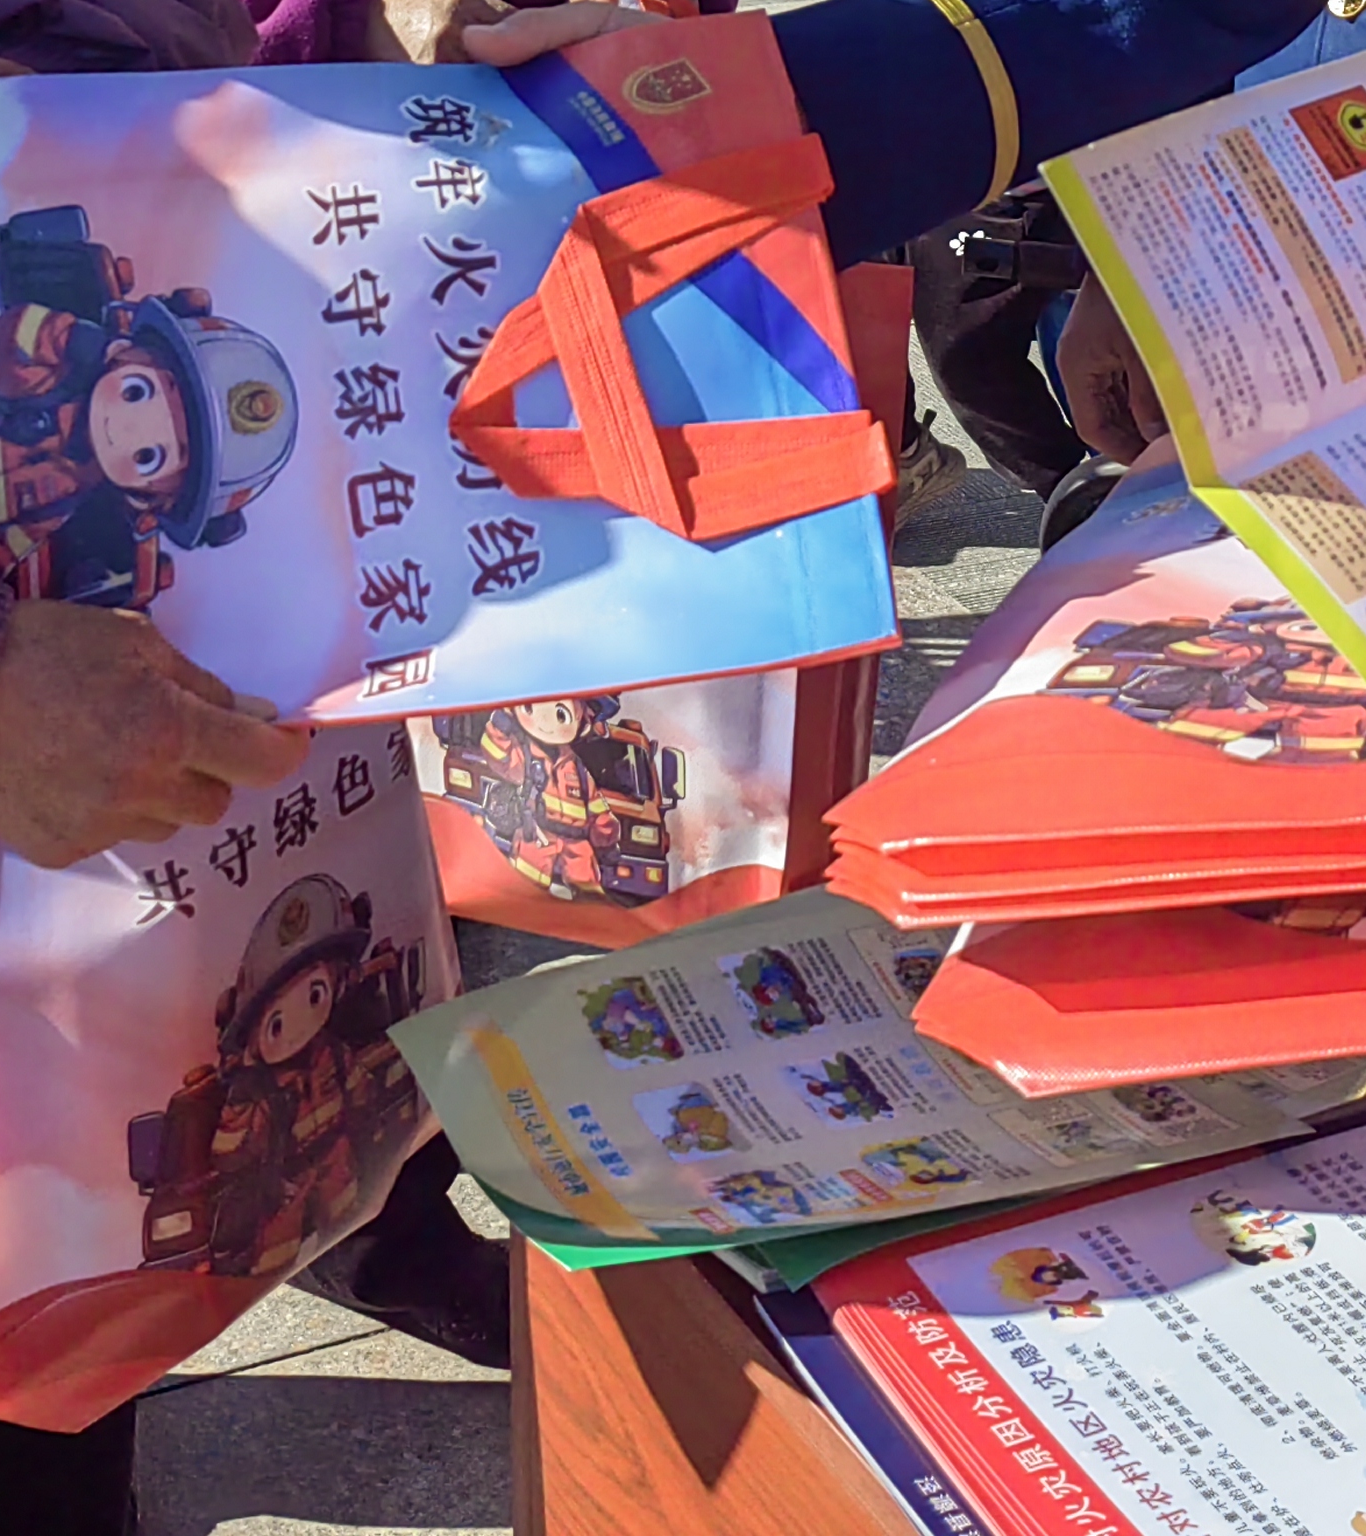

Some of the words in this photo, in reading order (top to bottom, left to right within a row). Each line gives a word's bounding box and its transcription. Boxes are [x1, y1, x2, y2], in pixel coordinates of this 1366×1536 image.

[135, 727, 412, 926] 共守绿色家
